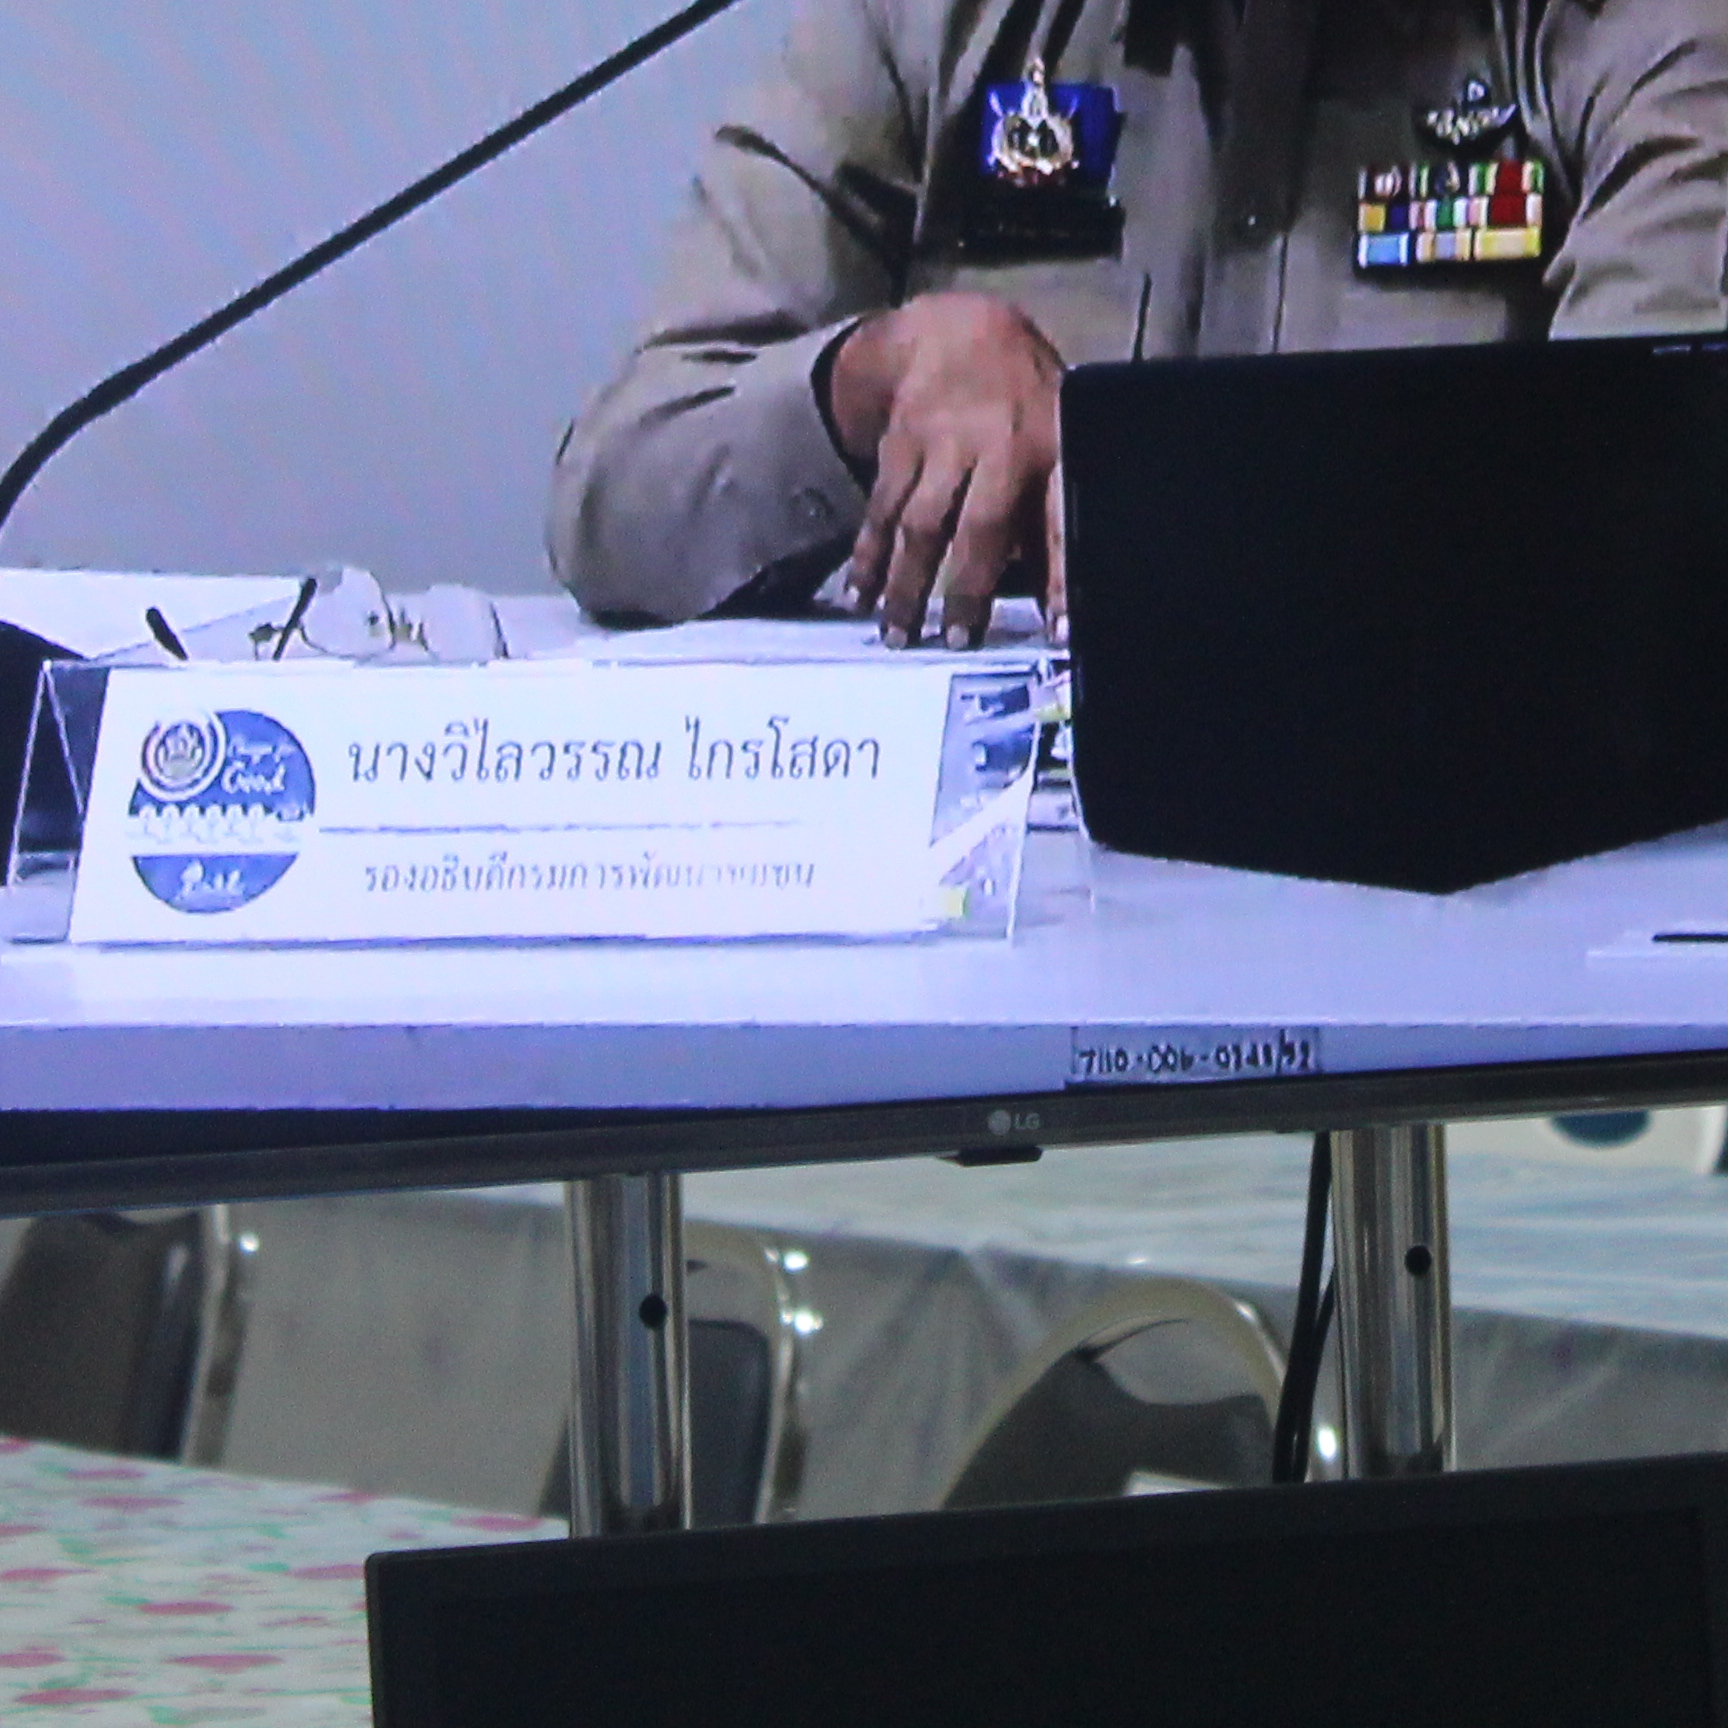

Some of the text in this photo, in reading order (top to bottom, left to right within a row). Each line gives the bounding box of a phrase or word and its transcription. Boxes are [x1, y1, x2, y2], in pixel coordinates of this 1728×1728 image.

[347, 717, 662, 784] นางวิไลวรรณ
[684, 714, 881, 781] ไกรโสดา
[1015, 1113, 1041, 1130] LG
